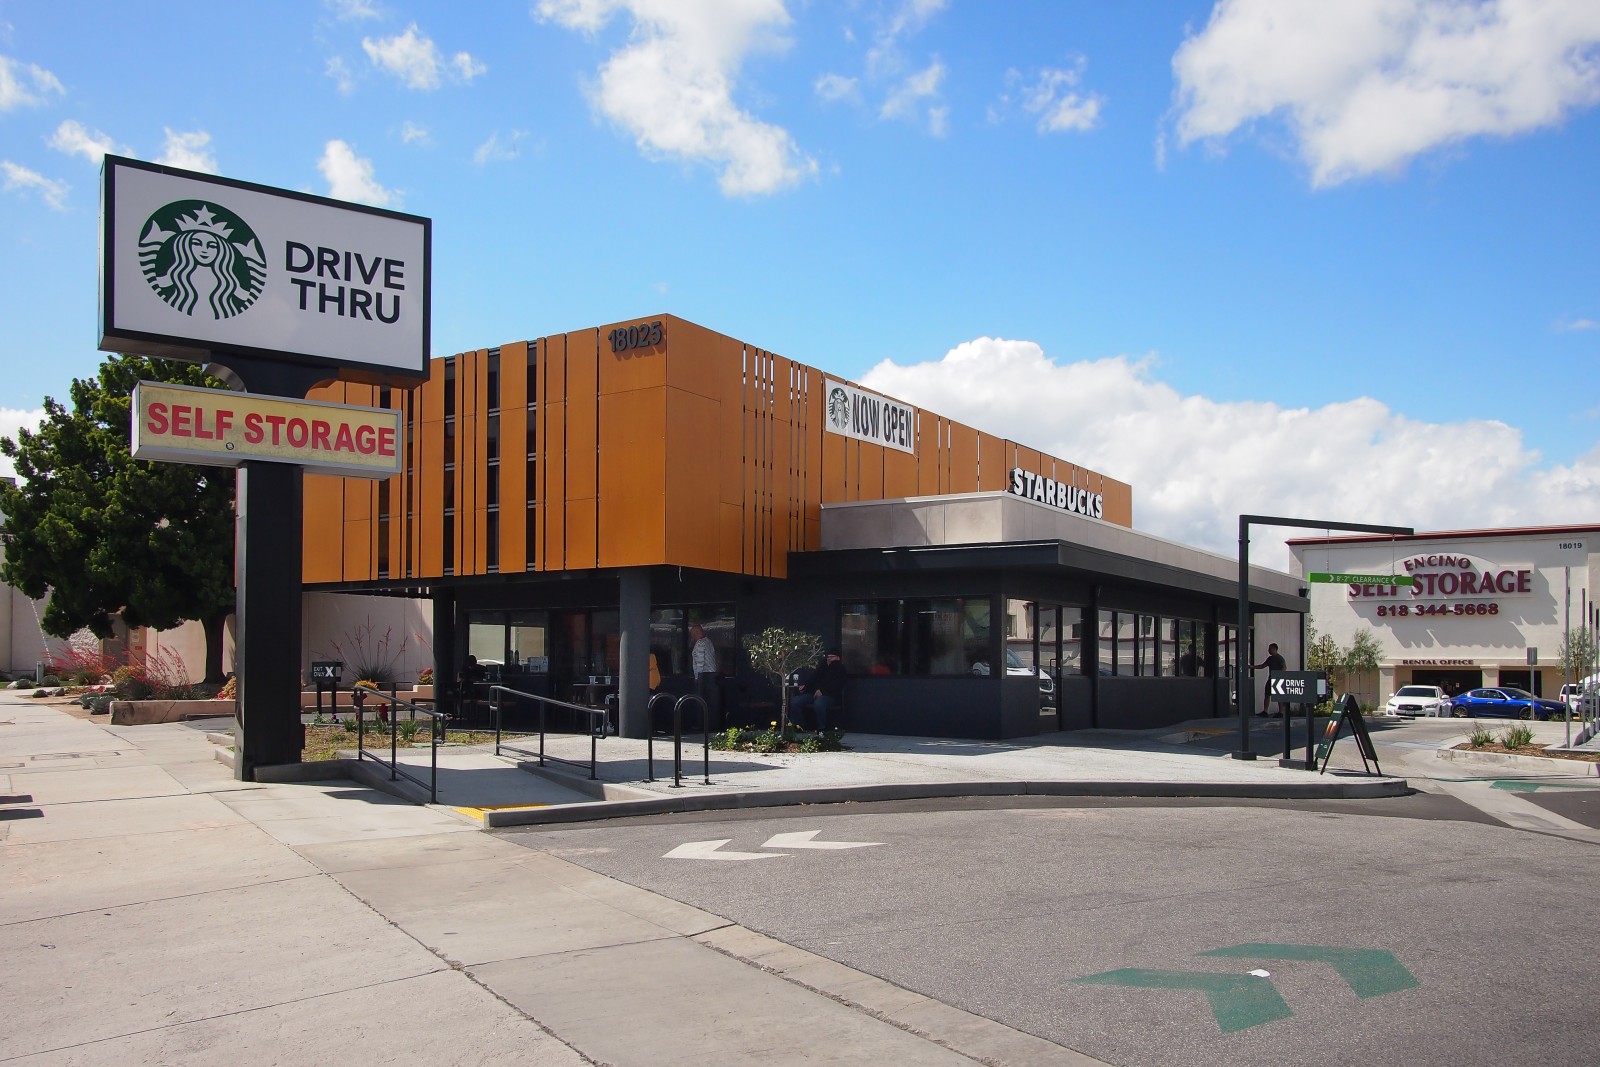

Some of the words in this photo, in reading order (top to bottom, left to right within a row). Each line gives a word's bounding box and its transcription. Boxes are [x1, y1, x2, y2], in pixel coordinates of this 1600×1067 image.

[286, 240, 405, 291] DRIVE
[291, 277, 400, 324] THRU
[608, 320, 663, 353] 18025
[147, 402, 234, 440] SELF
[244, 412, 396, 456] STORAGE
[852, 393, 880, 438] NOW
[883, 403, 912, 448] OPEN
[1010, 467, 1103, 519] STARBUCKS
[1559, 542, 1583, 550] 18019
[1403, 555, 1471, 572] ENCINO
[1352, 576, 1390, 584] CLEARANCE
[1411, 570, 1531, 596] STORAGE
[1285, 679, 1305, 687] DRIVE
[1285, 687, 1304, 695] THRU
